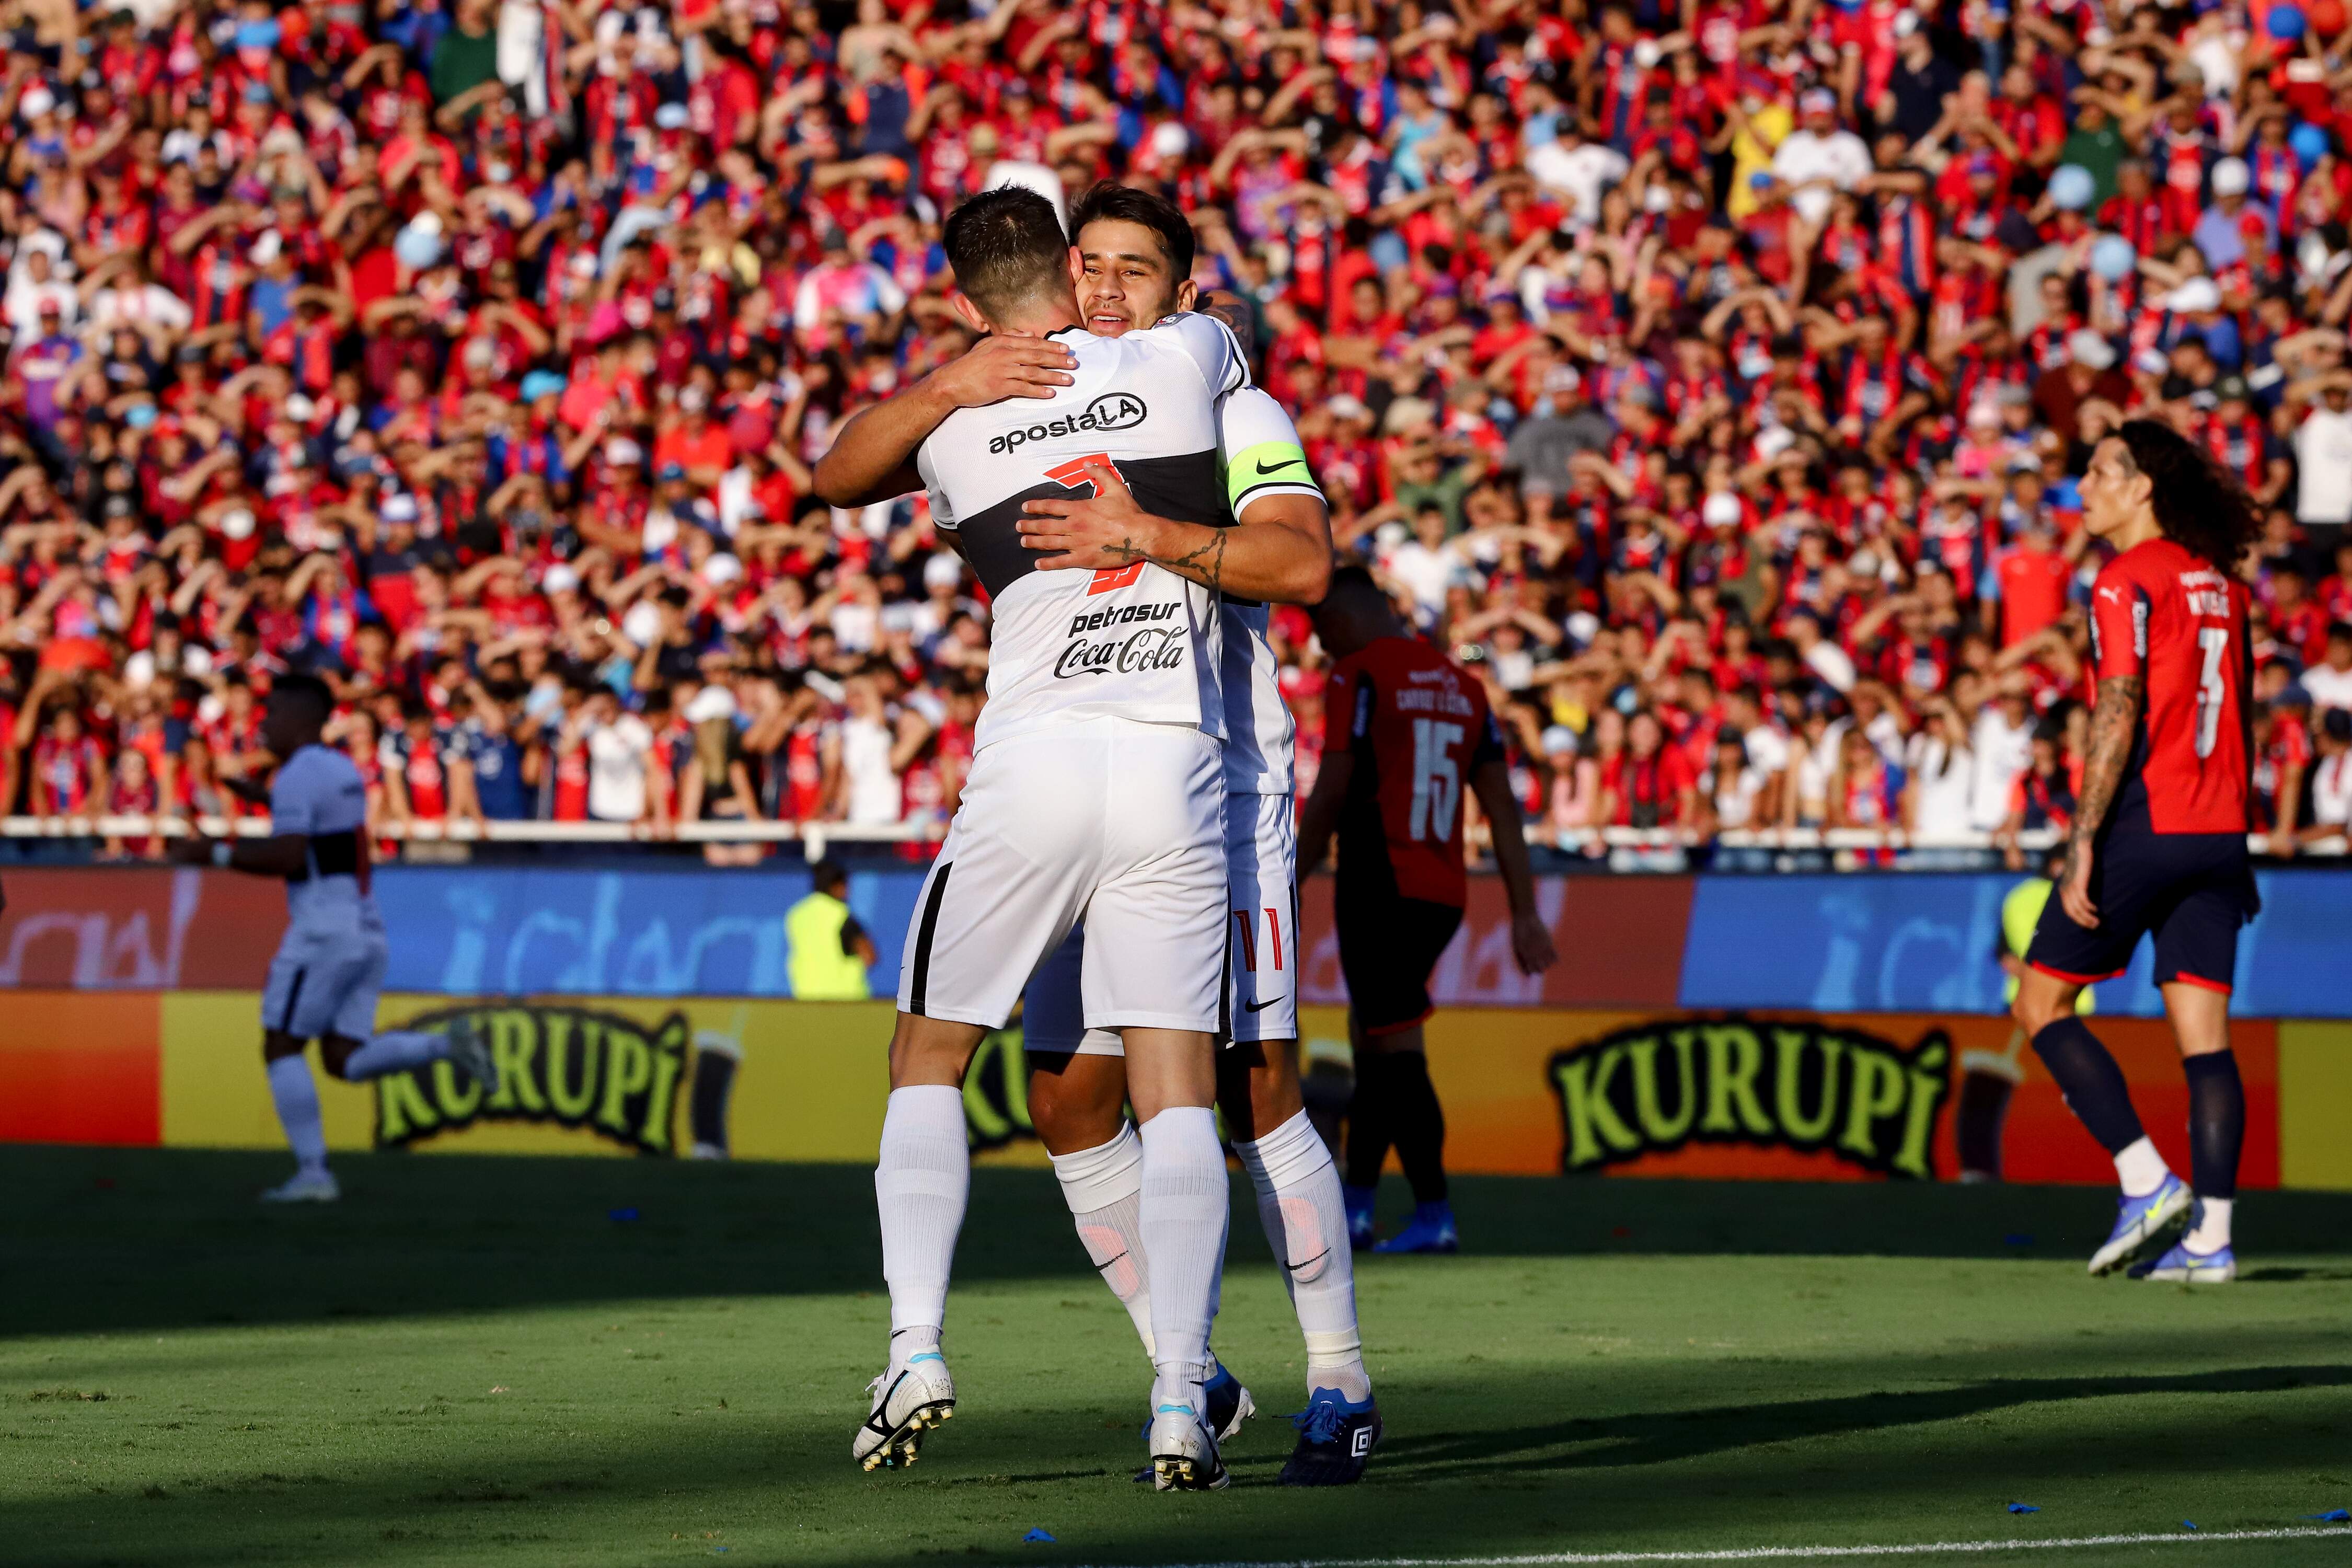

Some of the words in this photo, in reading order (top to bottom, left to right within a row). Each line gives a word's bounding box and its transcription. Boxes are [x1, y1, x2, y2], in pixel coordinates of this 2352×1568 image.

[1068, 602, 1182, 638] petrosur
[1053, 626, 1190, 679] Coca-Cola
[1409, 718, 1464, 843] 15
[1232, 908, 1283, 972] 11
[1555, 1024, 1947, 1178] KURUPÍ
